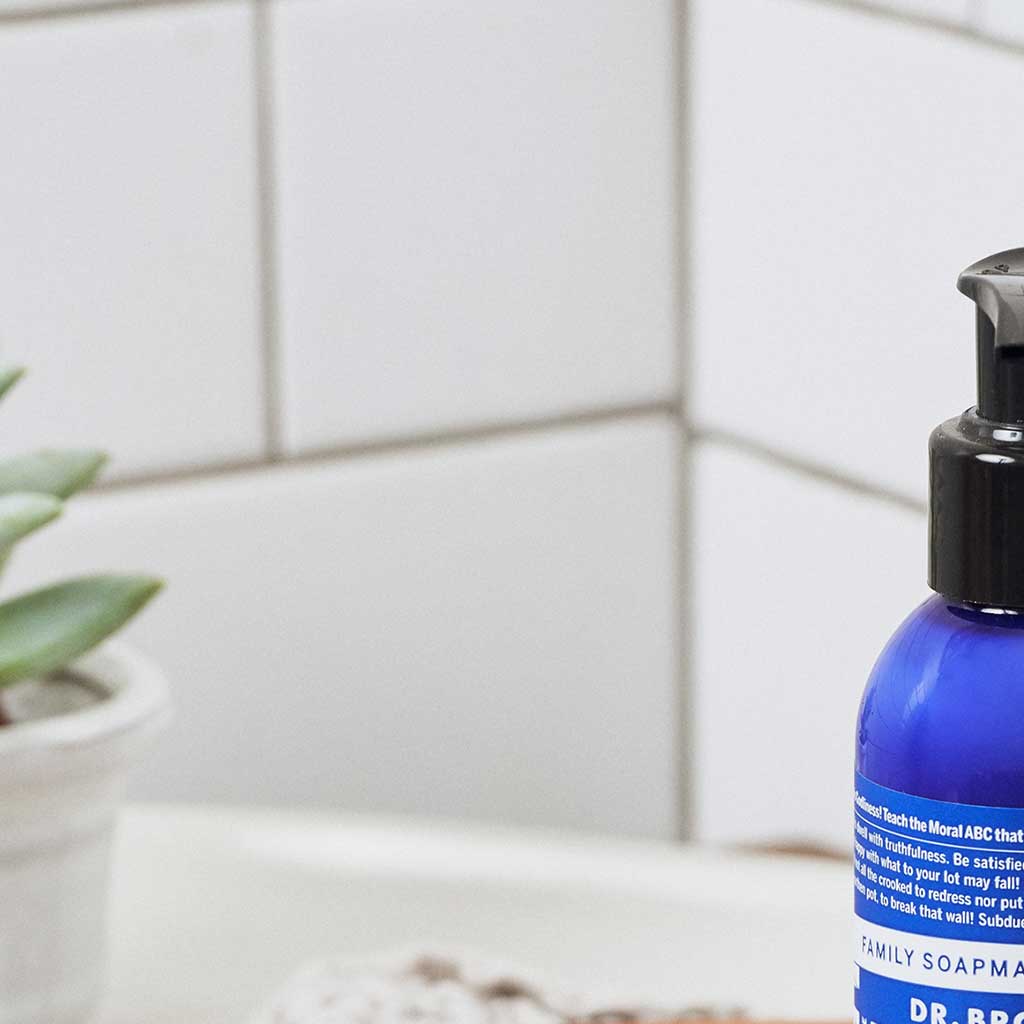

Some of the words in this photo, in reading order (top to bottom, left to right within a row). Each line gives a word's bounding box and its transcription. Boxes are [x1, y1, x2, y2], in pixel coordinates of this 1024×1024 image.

[883, 808, 908, 828] Teach
[909, 816, 927, 832] the
[929, 820, 962, 838] Moral
[964, 826, 993, 841] ABC
[995, 828, 1024, 843] that
[869, 832, 883, 848] with
[885, 838, 949, 864] truthfulness.
[953, 852, 969, 866] Be
[881, 856, 901, 873] what
[903, 862, 913, 876] to
[916, 867, 940, 882] your
[944, 871, 960, 885] lot
[964, 876, 990, 891] may
[995, 876, 1020, 890] fall!
[879, 875, 912, 895] crooked
[915, 884, 925, 898] to
[929, 889, 971, 905] redress
[975, 896, 997, 907] nor
[1001, 897, 1023, 911] put
[880, 893, 888, 906] to
[891, 896, 916, 915] break
[920, 905, 942, 920] that
[946, 910, 974, 925] wall!
[862, 935, 914, 968] FAMILY
